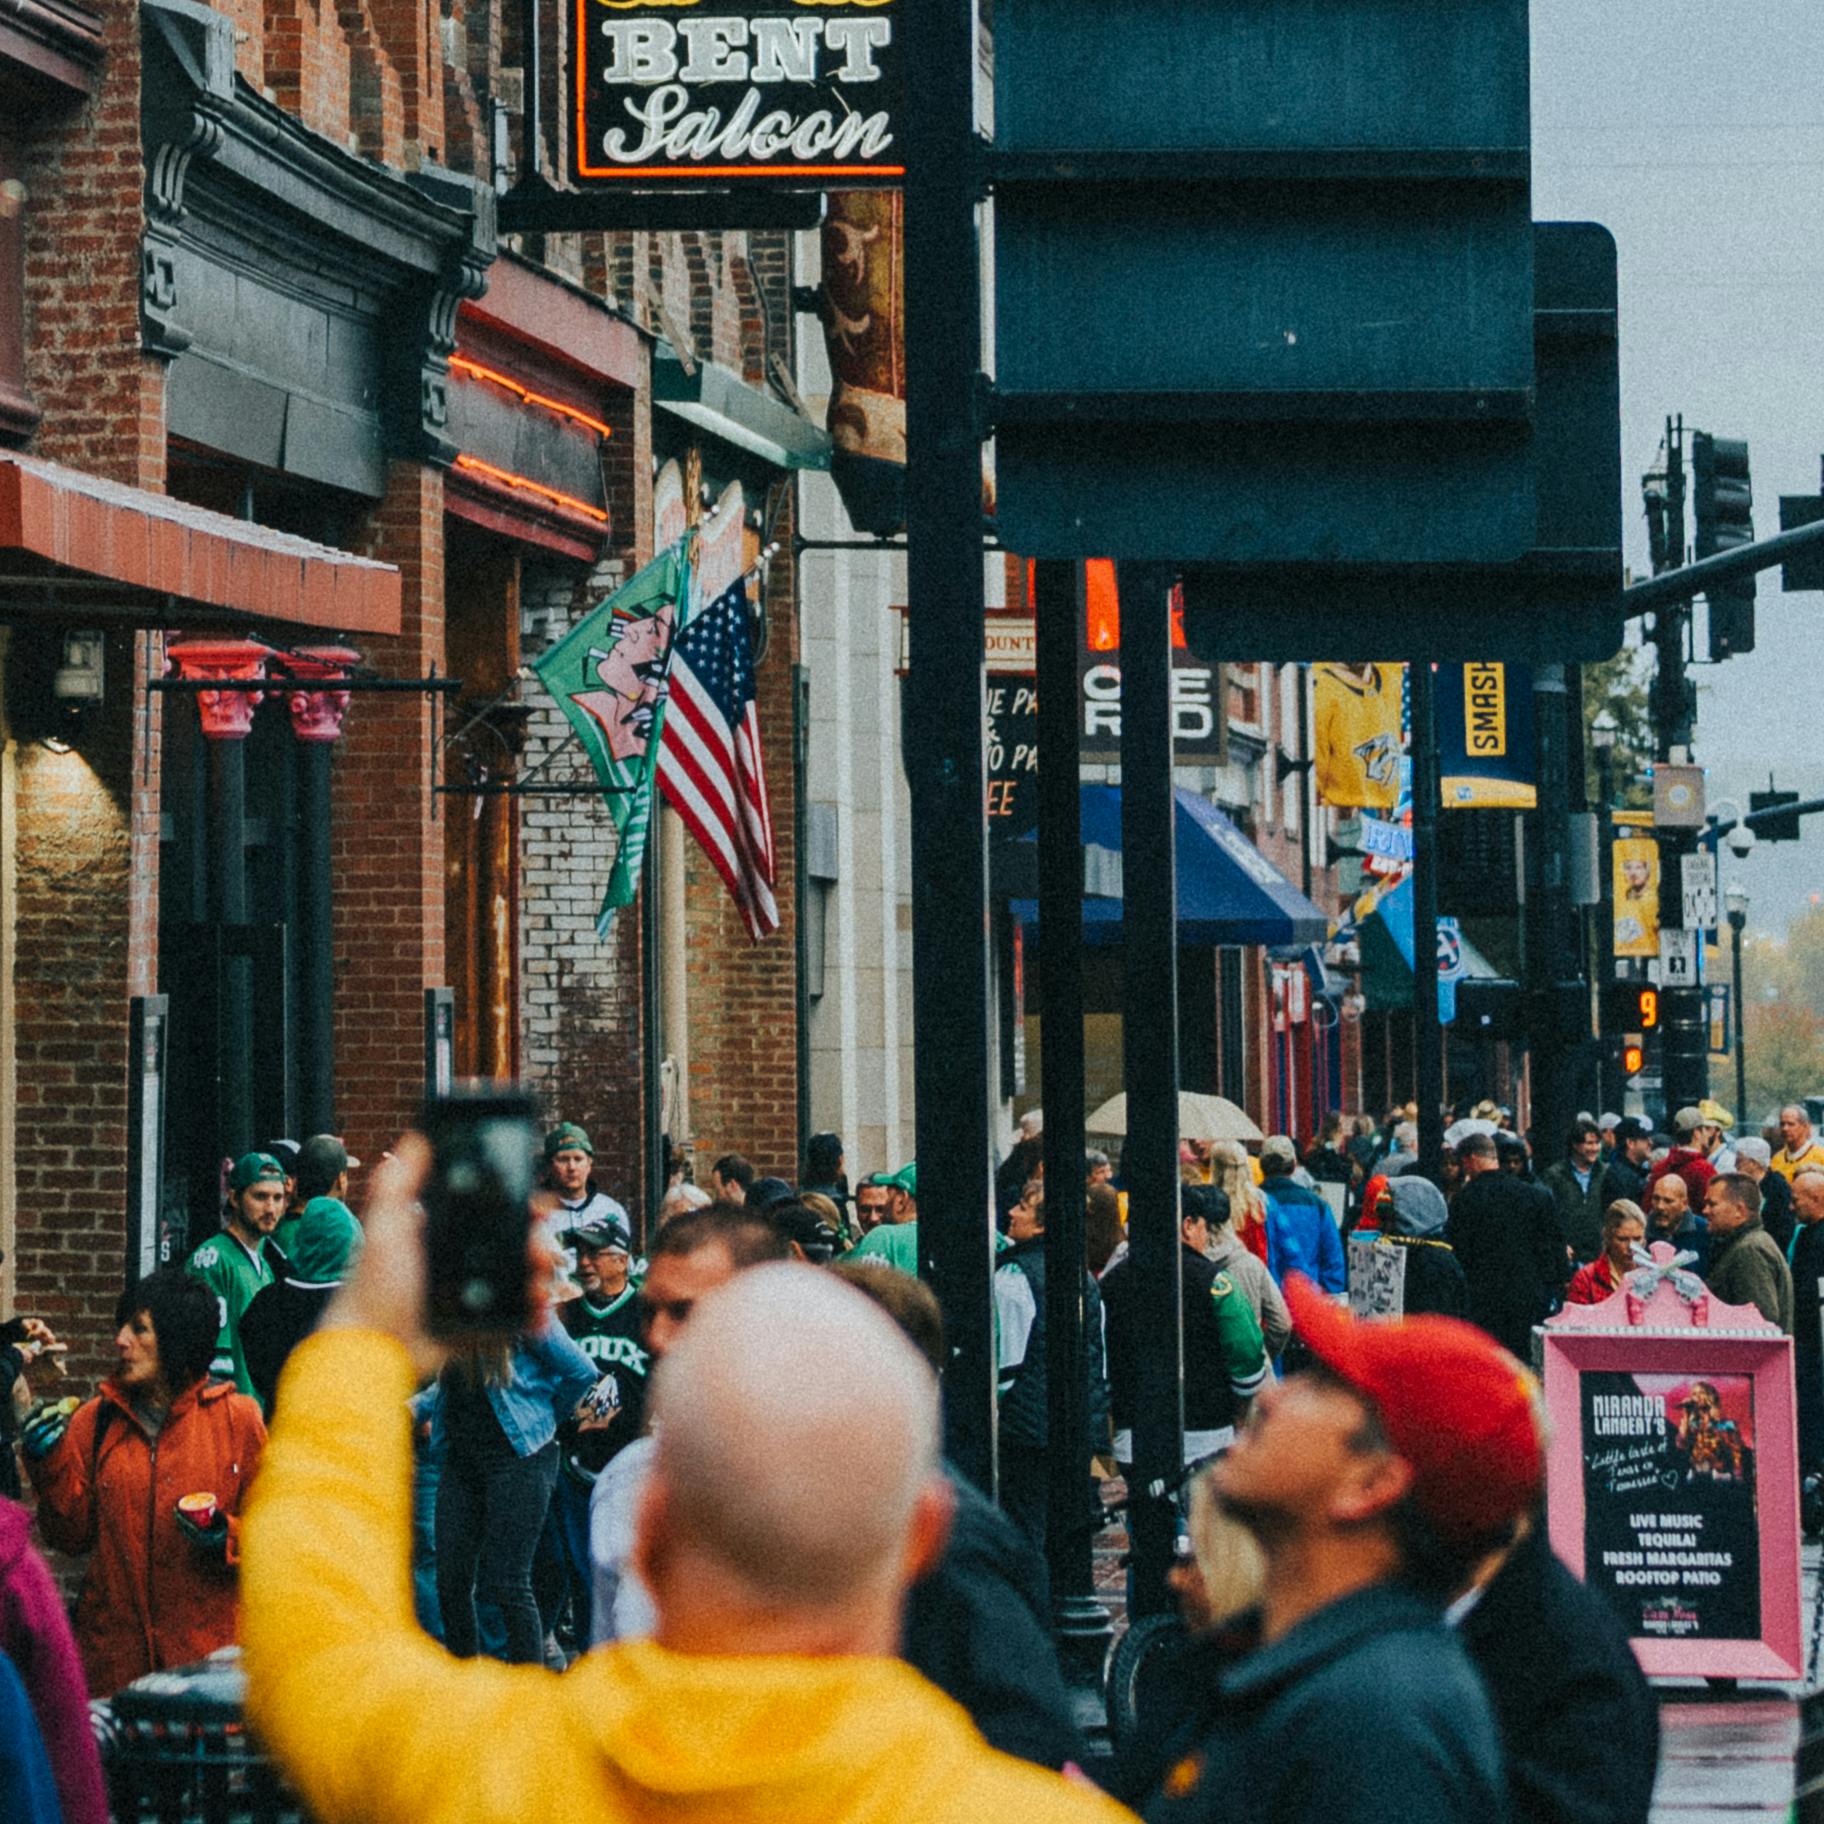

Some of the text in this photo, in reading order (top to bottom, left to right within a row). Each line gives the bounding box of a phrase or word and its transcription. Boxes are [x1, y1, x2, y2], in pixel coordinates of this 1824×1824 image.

[602, 16, 890, 85] BENT
[604, 85, 892, 164] Saloon
[1593, 1395, 1665, 1417] MIRANDA
[1595, 1417, 1666, 1436] LAMBERT'S
[1630, 1513, 1704, 1529] LIVE MUSIC
[1637, 1532, 1697, 1548] TEQUILA!
[1603, 1551, 1733, 1567] FRESH MARGARITAS
[1615, 1569, 1722, 1585] ROOFTOP PATIO
